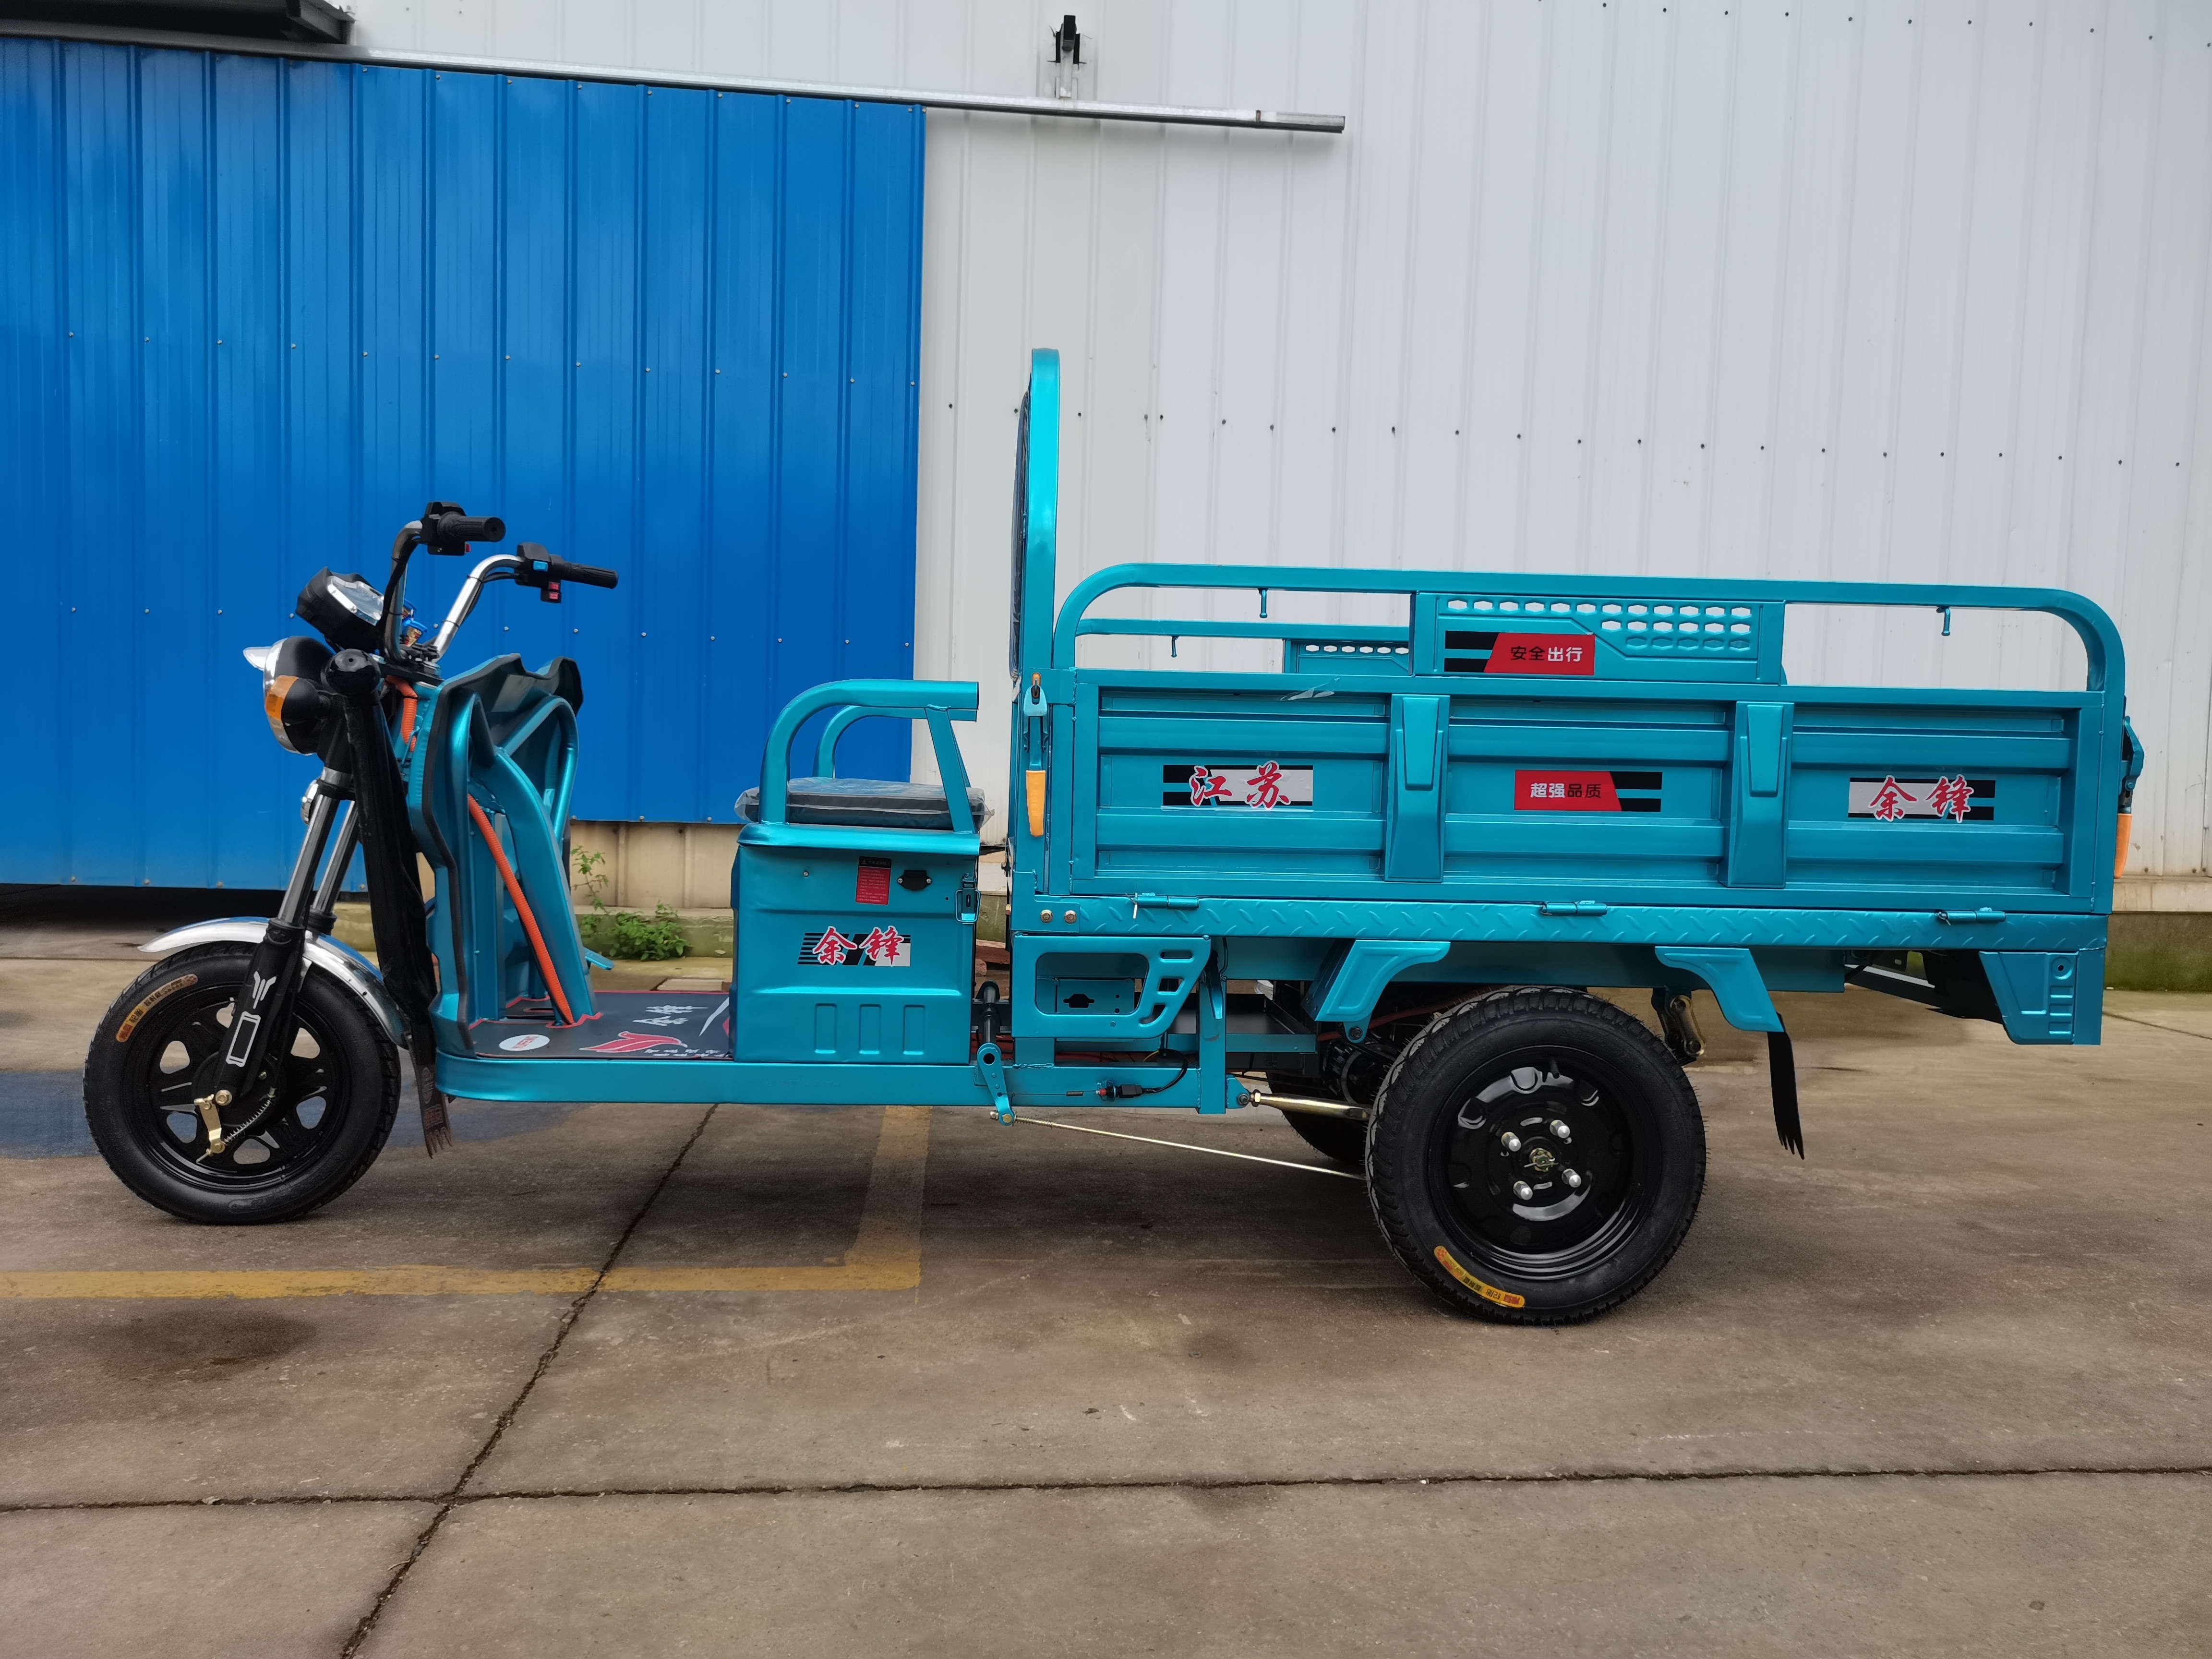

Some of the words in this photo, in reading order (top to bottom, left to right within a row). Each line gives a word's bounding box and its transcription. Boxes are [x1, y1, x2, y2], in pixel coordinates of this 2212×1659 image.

[1511, 646, 1583, 662] 安全出行
[1190, 762, 1290, 809] 江苏
[1530, 783, 1601, 798] 超强品质
[1870, 776, 1972, 820] 余锋
[814, 927, 903, 964] 余锋
